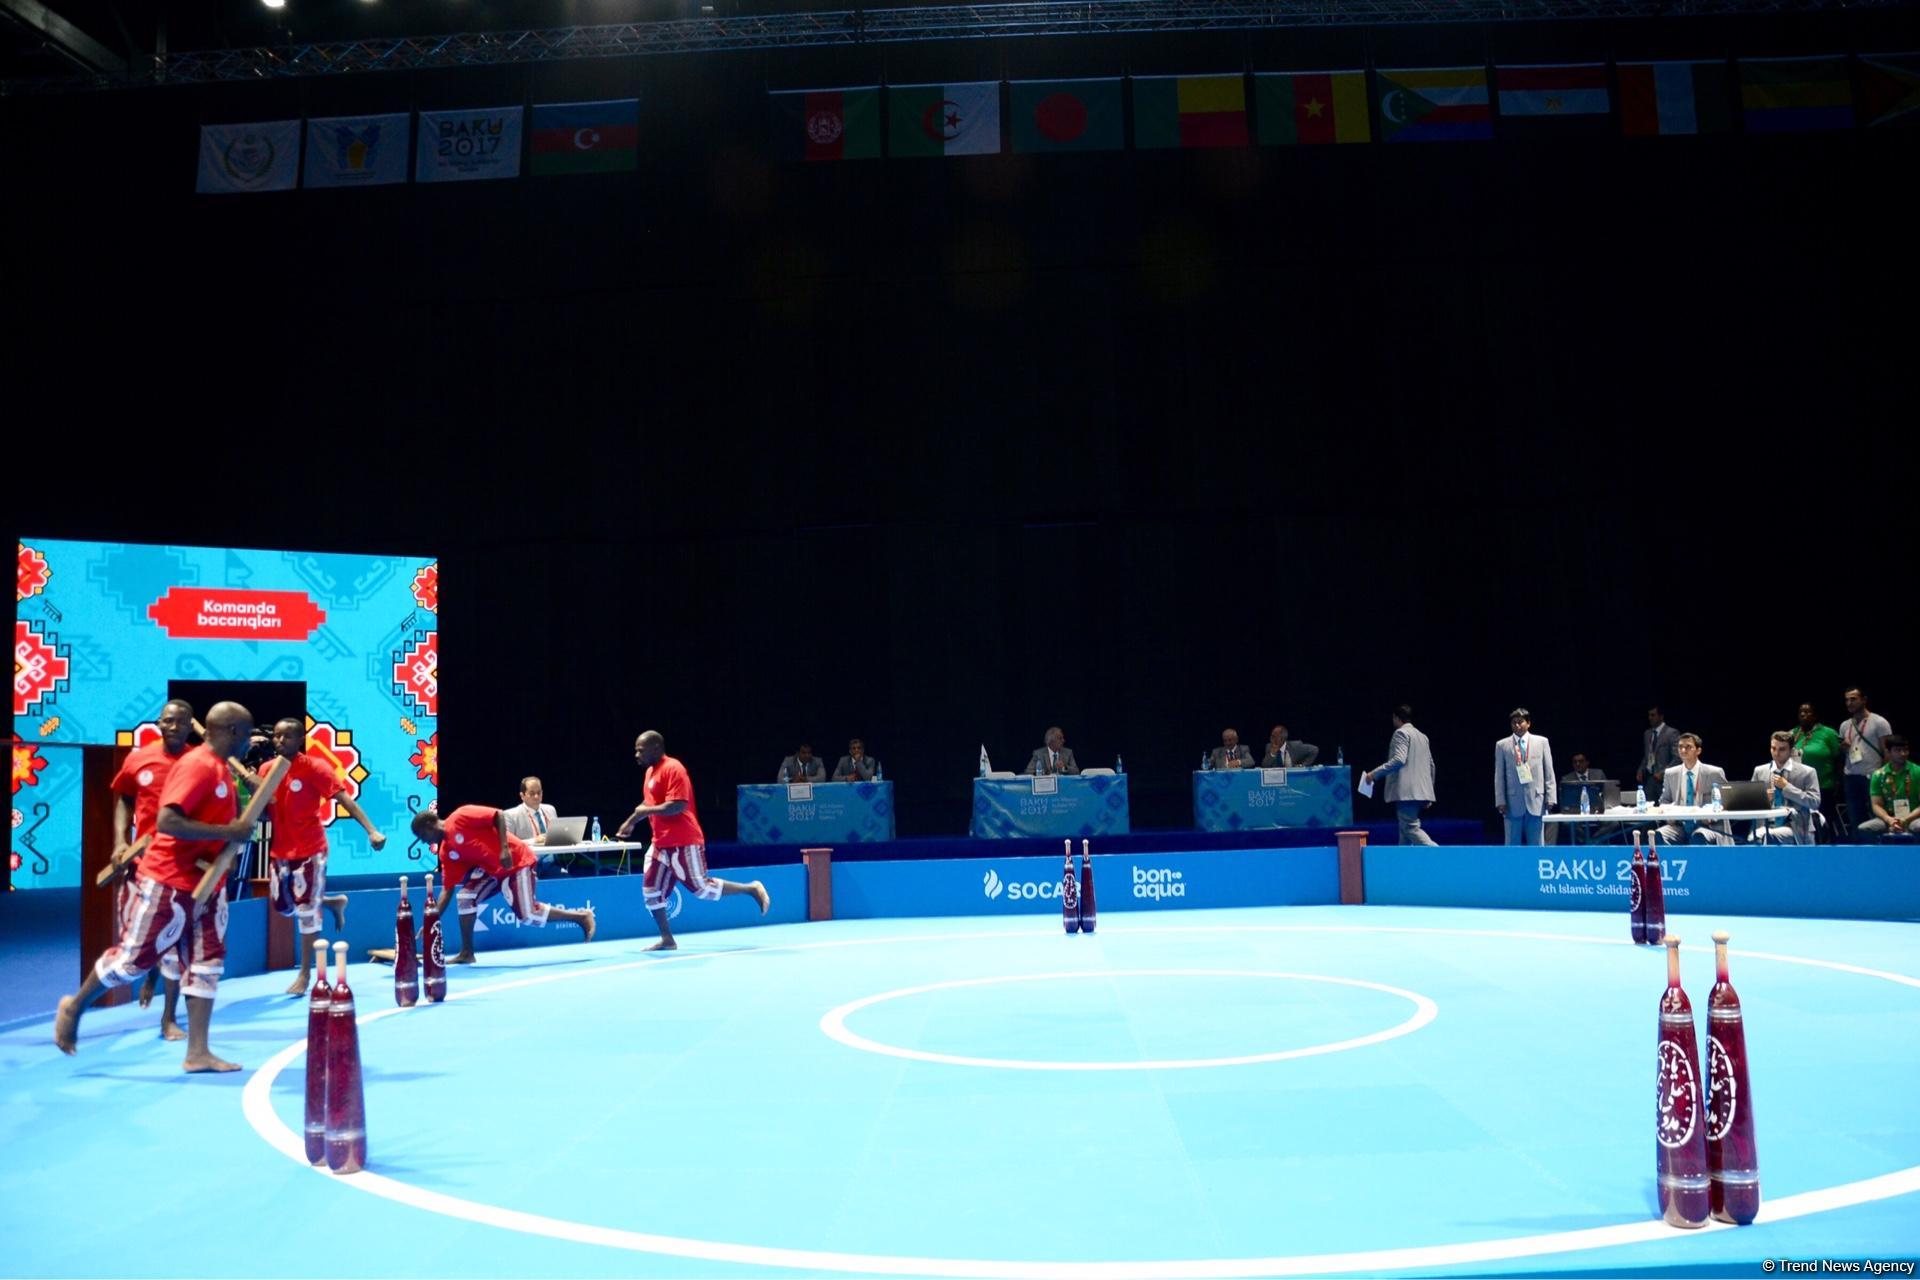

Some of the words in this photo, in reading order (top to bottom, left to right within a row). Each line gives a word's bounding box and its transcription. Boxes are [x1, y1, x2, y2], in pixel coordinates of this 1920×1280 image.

[440, 118, 503, 137] BAKU
[439, 136, 500, 156] 2017
[203, 600, 276, 614] Komanda
[1538, 860, 1607, 880] BAKU
[1616, 860, 1688, 881] 217
[1132, 884, 1185, 901] aqua
[1540, 884, 1557, 894] 4th
[1559, 884, 1594, 895] Islamic
[1661, 886, 1690, 897] ames
